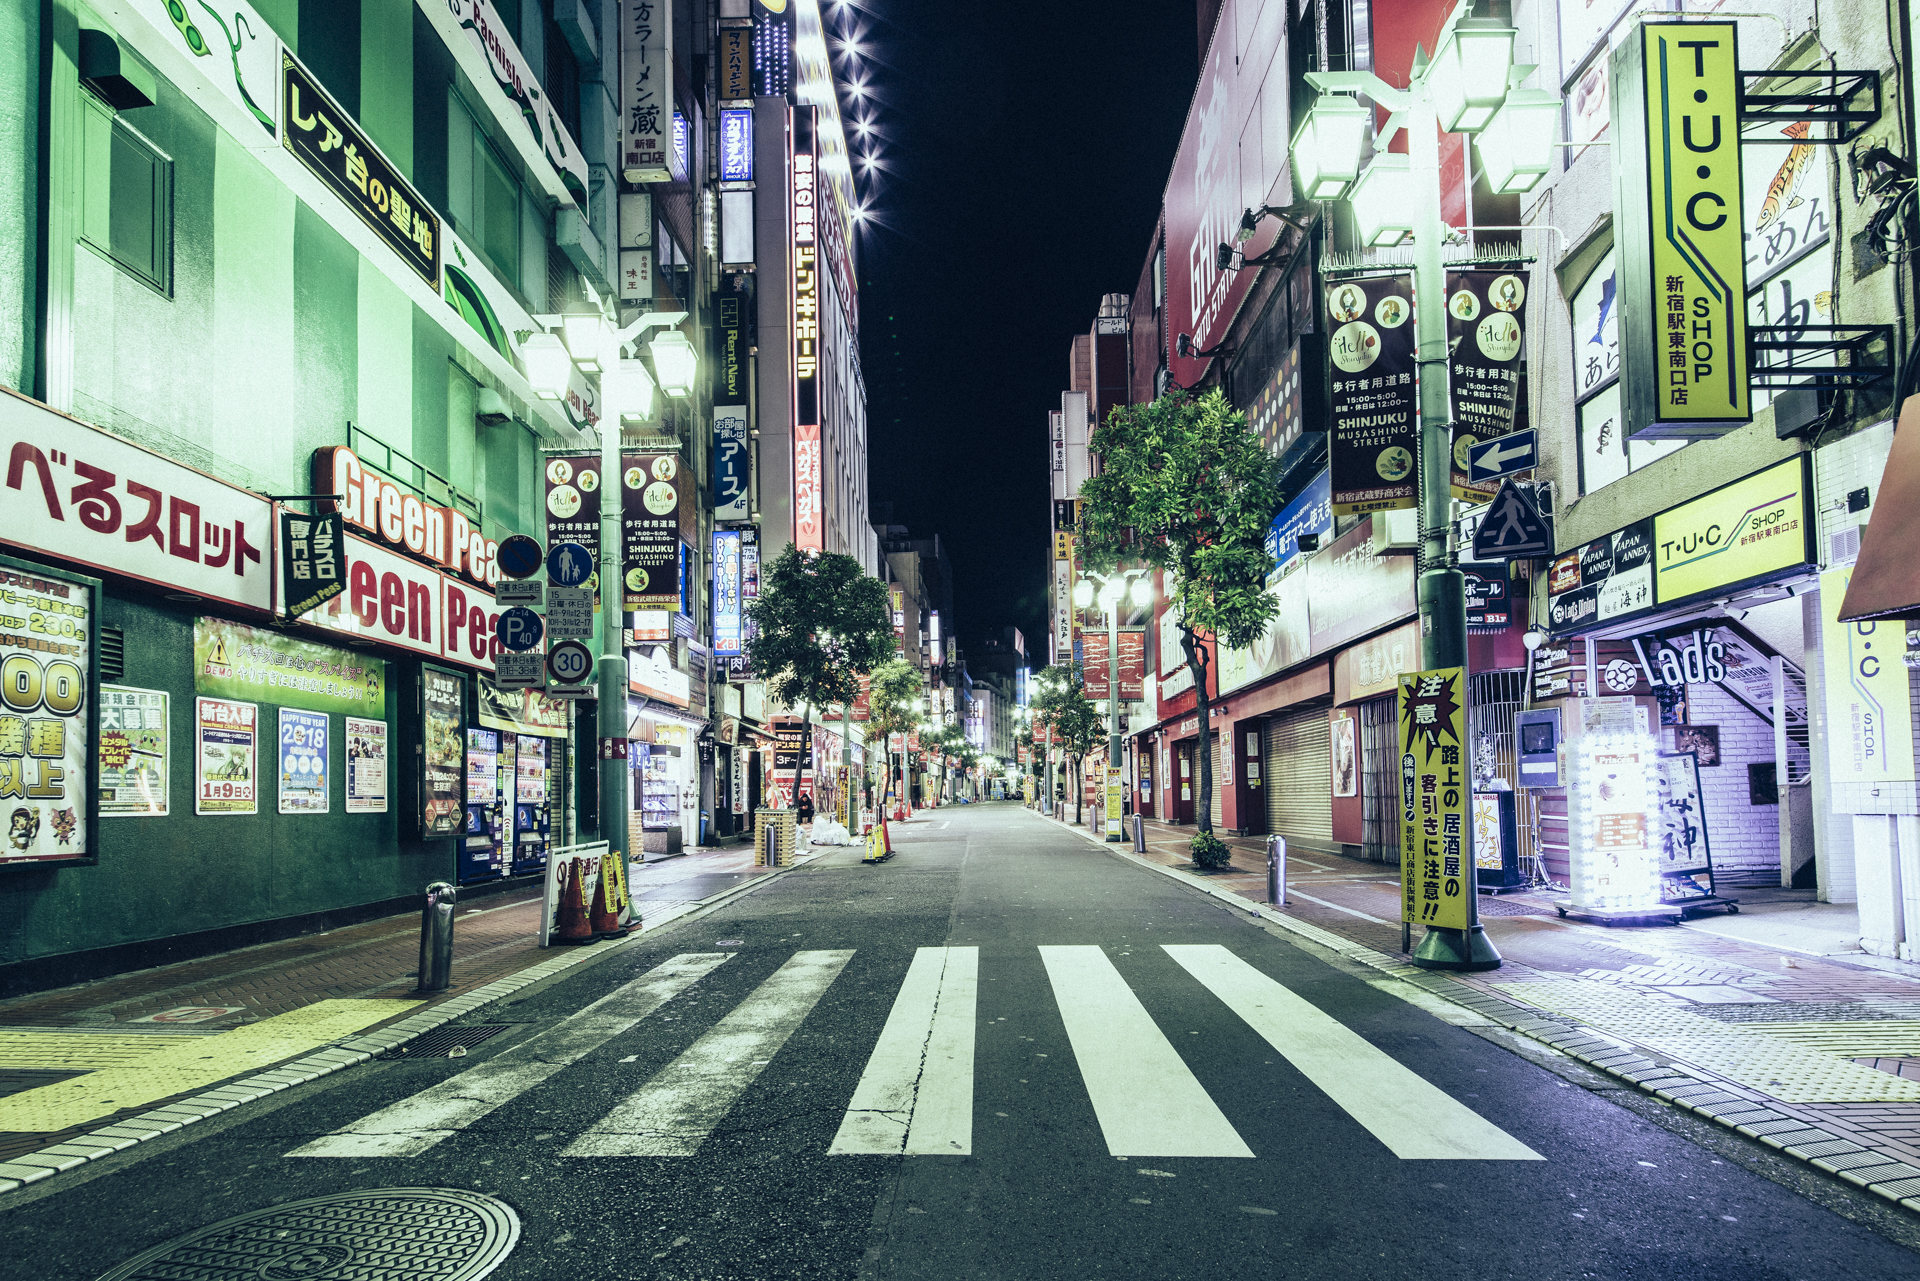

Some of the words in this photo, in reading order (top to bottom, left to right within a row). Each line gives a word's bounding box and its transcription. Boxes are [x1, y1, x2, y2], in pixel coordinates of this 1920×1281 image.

[473, 1, 523, 96] Pachislo
[729, 32, 746, 96] タウンハウジング
[634, 138, 656, 149] 新宿
[727, 117, 742, 166] カラオケ
[626, 151, 665, 164] 南口店
[291, 82, 433, 260] レア台の聖地
[626, 268, 638, 290] 味王
[1193, 303, 1211, 360] TAITO
[1666, 275, 1688, 406] 新宿駅東南口店
[1692, 296, 1713, 384] SHOP
[1333, 372, 1411, 393] 歩行者用道路
[1454, 364, 1517, 383] 歩行者用道路
[1338, 412, 1407, 429] SHINJUKU
[1459, 401, 1511, 420] SHINJUKU
[715, 418, 745, 430] お部屋
[1460, 413, 1510, 430] MUSASHINO
[1472, 424, 1500, 437] STREET
[721, 430, 745, 439] 探しは
[1338, 425, 1408, 440] MUSASHINO
[1353, 436, 1392, 448] STREET
[721, 442, 740, 496] アース
[797, 440, 812, 524] ベガスベガス
[734, 500, 746, 509] 4F
[1336, 487, 1414, 502] 新宿武蔵野商栄会
[6, 441, 260, 577] べるスロット
[334, 447, 446, 565] Green
[451, 508, 516, 588] Pea
[1352, 501, 1397, 513] 路上喫煙禁止
[549, 523, 599, 531] 歩行者用道路
[626, 520, 676, 528] 歩行者用道路
[1752, 509, 1785, 529] SHOP
[1616, 534, 1640, 552] JAPAN
[1741, 519, 1798, 546] 新宿駅東南口店
[290, 520, 311, 579] 専門店
[313, 518, 336, 579] パチスロ
[629, 545, 674, 553] SHINJUKU
[1582, 549, 1605, 565] JAPAN
[1621, 544, 1649, 562] ANNEX
[1588, 558, 1612, 575] ANNEX
[290, 595, 320, 616] Green
[316, 582, 342, 599] Peas
[583, 591, 589, 599] 5
[29, 612, 75, 638] 230
[448, 584, 502, 664] Pea
[507, 617, 524, 644] P
[519, 633, 532, 645] 40
[727, 639, 739, 650] B1
[558, 653, 583, 672] 30
[730, 658, 743, 671] 肉
[1358, 642, 1404, 686] 麻雀入口
[1632, 628, 1724, 687] Lad's
[205, 664, 233, 678] DEMO
[1726, 665, 1770, 680] BOURBON
[102, 707, 162, 729] 大募集
[201, 703, 254, 726] 新台入替
[282, 714, 300, 724] HAPPY
[300, 717, 312, 727] NEW
[312, 719, 325, 727] YEAR
[1414, 676, 1444, 746] 注意!
[282, 724, 325, 749] 2018
[1863, 712, 1876, 760] SHOP
[1441, 745, 1461, 898] 路上の居酒屋の
[1420, 773, 1440, 921] 客引きに注意!!
[1405, 825, 1415, 922] 新宿東口商店街振興組合
